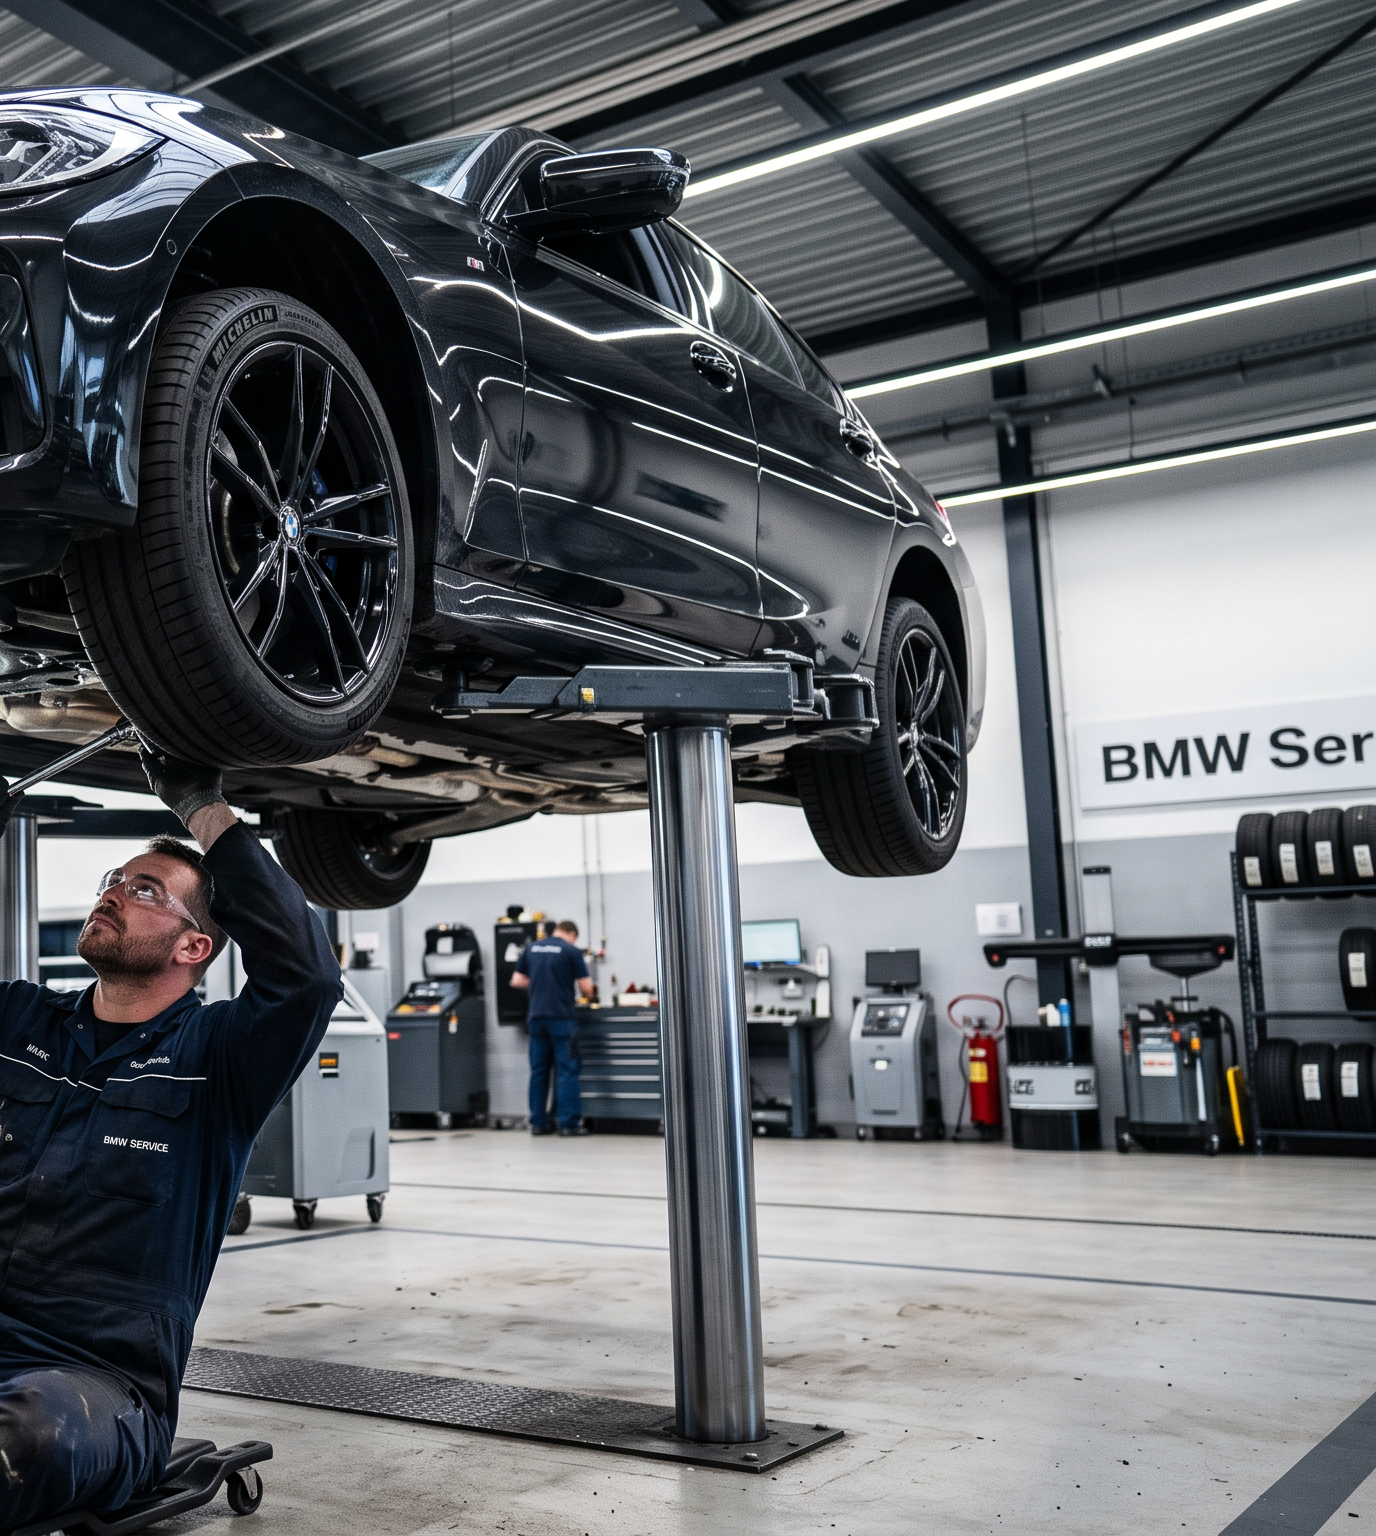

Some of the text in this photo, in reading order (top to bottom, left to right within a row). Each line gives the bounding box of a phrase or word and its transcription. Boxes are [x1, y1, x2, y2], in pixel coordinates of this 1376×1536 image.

[212, 307, 274, 366] MICHELIN
[1101, 726, 1374, 784] BMW Ser
[103, 1135, 169, 1153] BMW SERVICE
